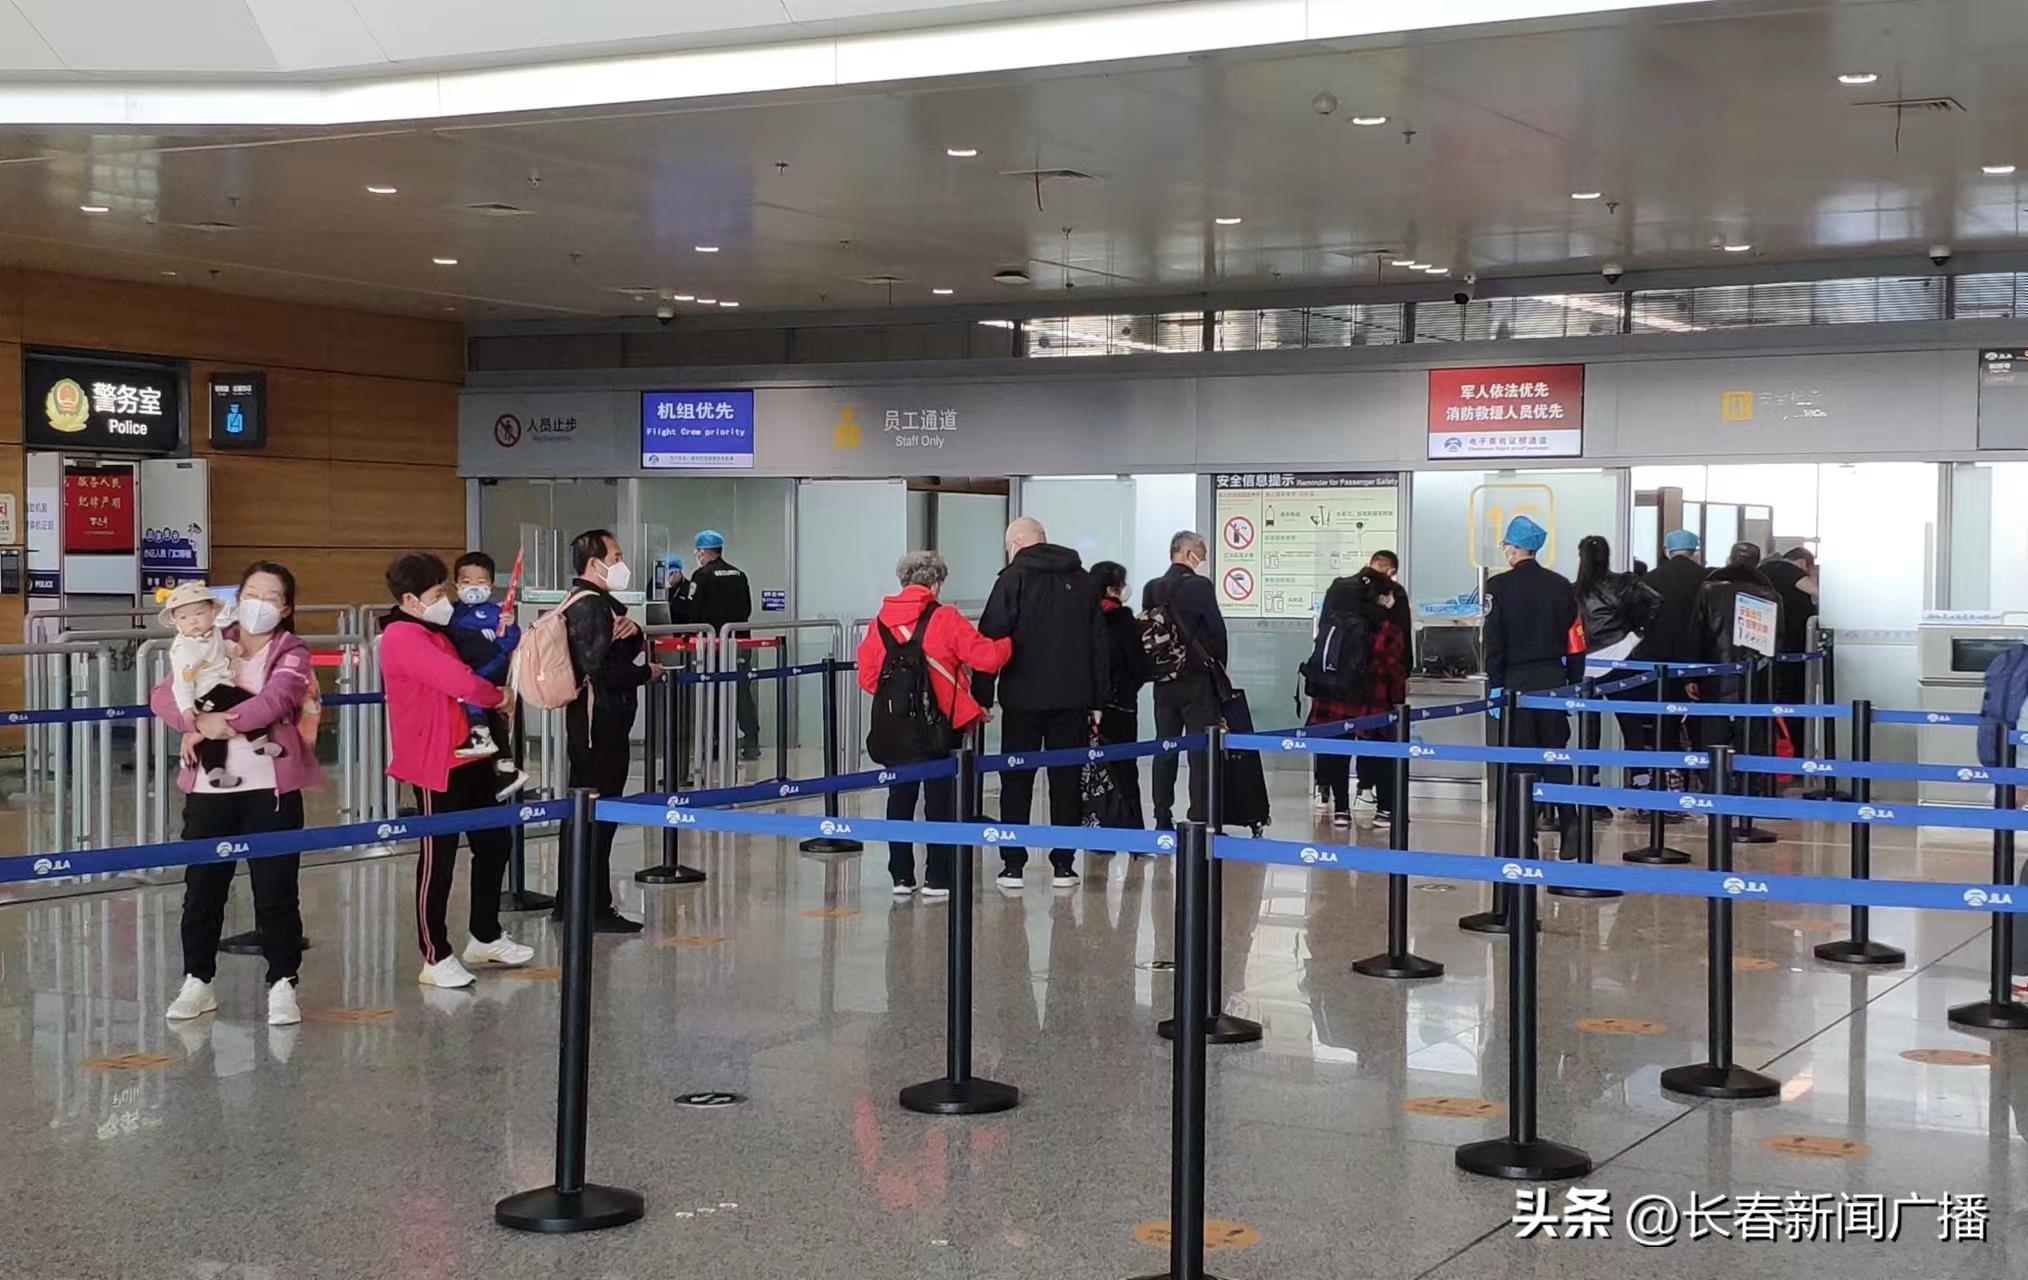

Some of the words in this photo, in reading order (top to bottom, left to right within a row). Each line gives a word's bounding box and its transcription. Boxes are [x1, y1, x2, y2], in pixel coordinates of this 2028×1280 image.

[1460, 381, 1549, 399] 军人依法优先
[92, 382, 162, 415] 警务室
[657, 402, 734, 419] 机组优先
[1446, 403, 1564, 421] 消防救援人员优先
[527, 416, 576, 432] 人员止步
[884, 409, 957, 431] 员工通道
[108, 419, 148, 435] Police
[646, 428, 676, 437] Flight
[705, 428, 745, 437] priority
[895, 435, 918, 447] Staff
[921, 435, 944, 448] Only
[1216, 473, 1295, 488] 安全信息提示
[1296, 479, 1328, 487] Reminder
[1339, 478, 1375, 488] Passenger
[1376, 478, 1398, 486] Safety
[34, 580, 54, 588] POLICE
[1294, 741, 1306, 749] JLA
[1557, 753, 1570, 761] JLA
[1972, 771, 1988, 779] JLA
[1696, 800, 1712, 808] JLA
[532, 807, 546, 817] JLA
[1875, 809, 1894, 818] JLA
[680, 813, 695, 823] JLA
[391, 824, 406, 834] JLA
[836, 824, 851, 833] JLA
[999, 831, 1016, 841] JLA
[233, 843, 249, 853] JLA
[1318, 852, 1337, 863] JLA
[52, 860, 71, 870] JLA
[1522, 868, 1543, 878] JLA
[1745, 881, 1768, 892] JLA
[1988, 892, 2012, 904] JLA
